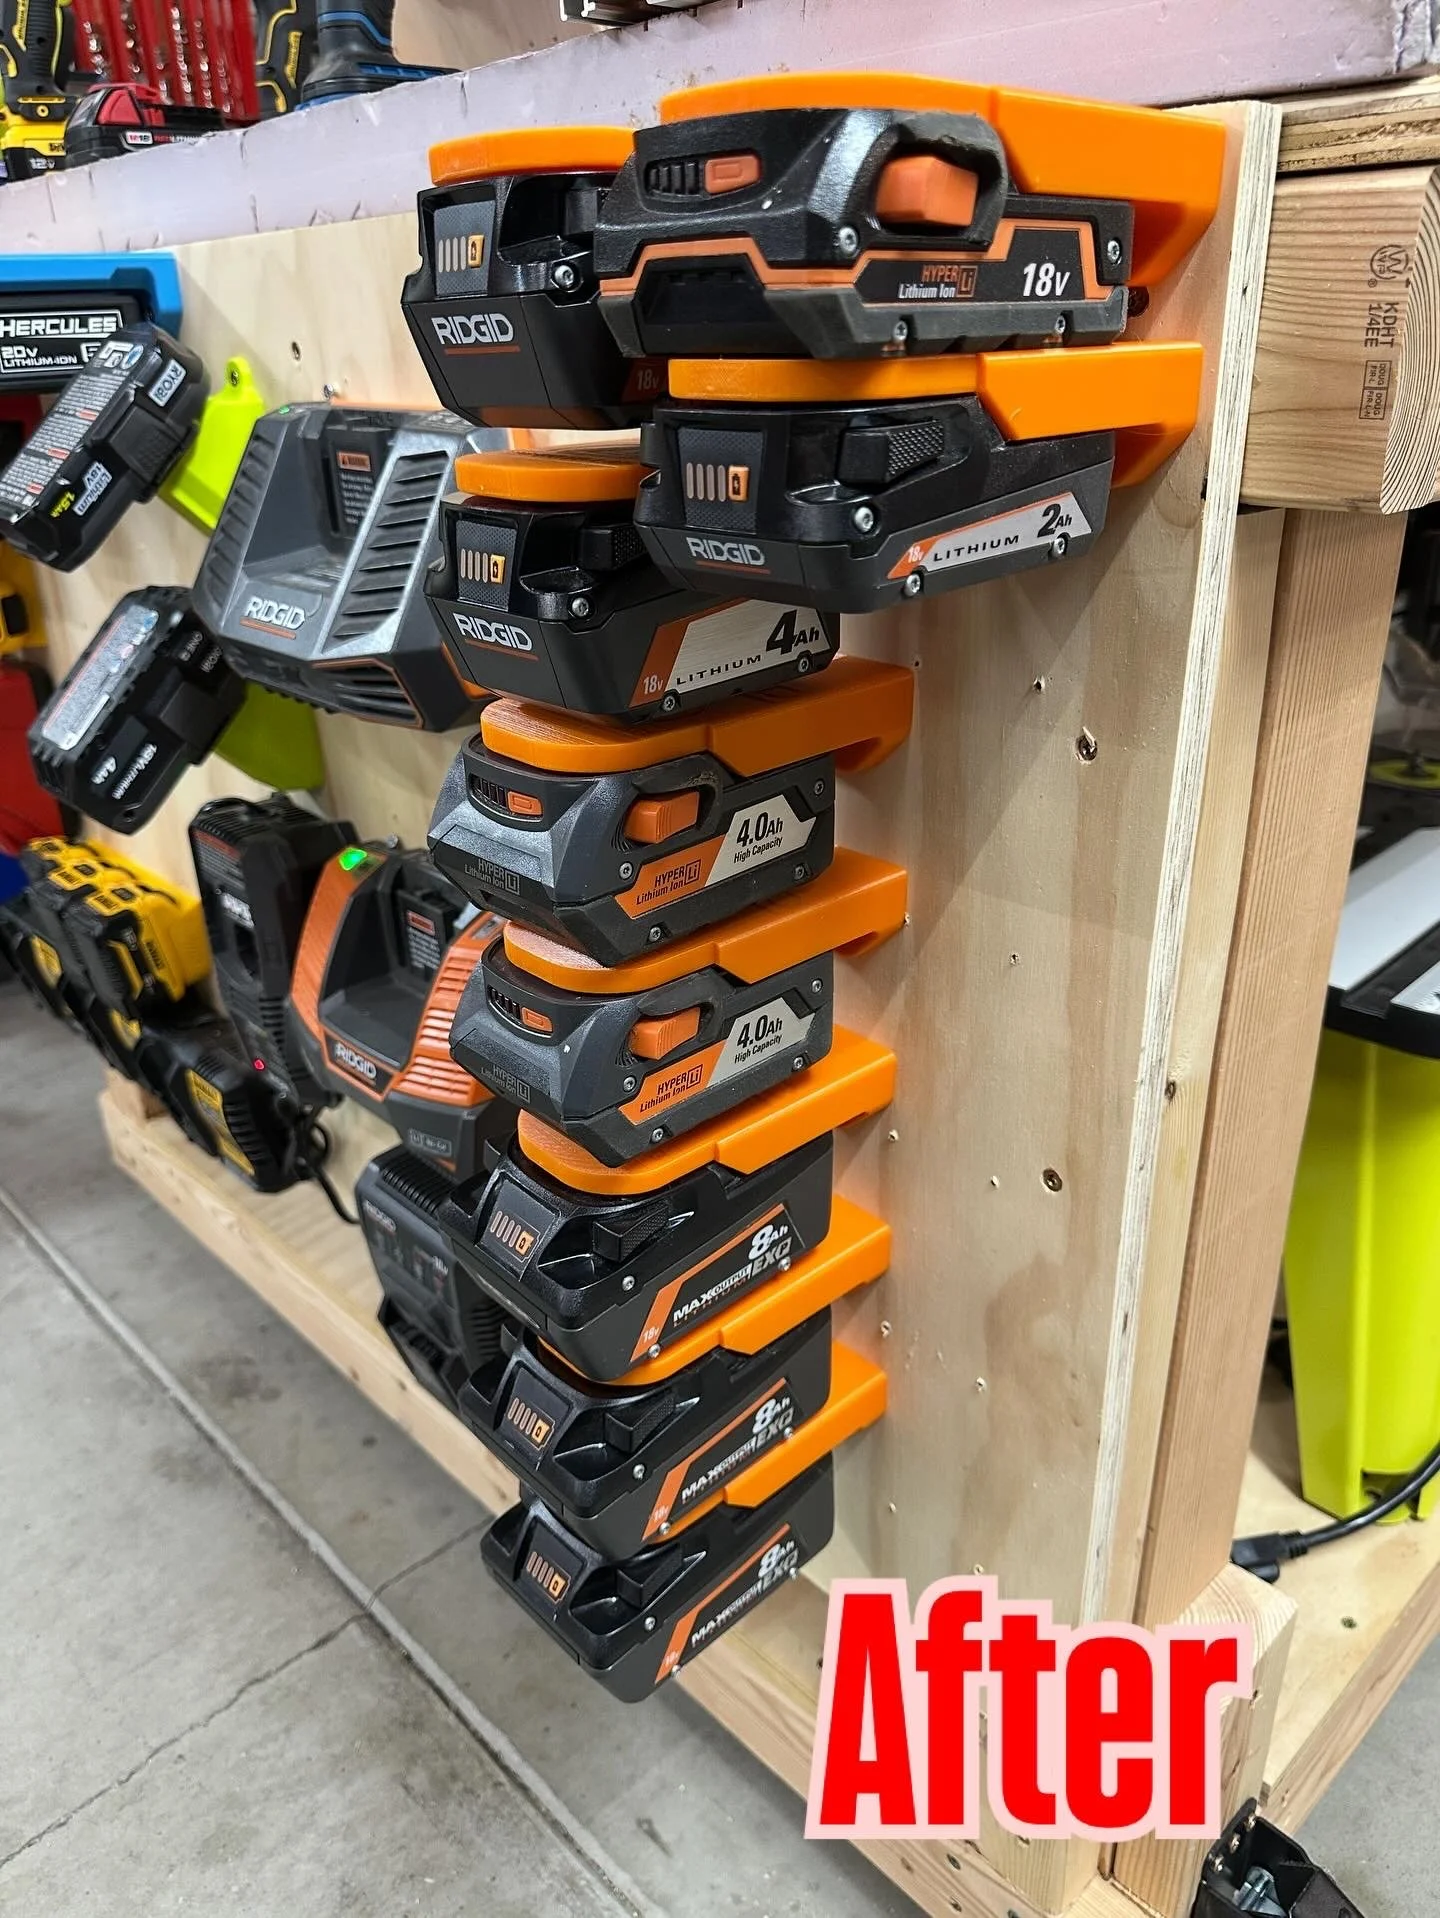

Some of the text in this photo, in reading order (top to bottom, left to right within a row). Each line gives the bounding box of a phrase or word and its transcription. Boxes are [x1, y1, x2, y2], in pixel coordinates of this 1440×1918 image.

[921, 265, 960, 282] HYPER
[898, 283, 955, 299] Lithium Ion
[0, 316, 117, 338] HERCULES
[430, 312, 514, 345] RIDGID
[1380, 302, 1399, 348] KDHT
[153, 363, 182, 402] RYOBI
[1377, 363, 1387, 386] DOUG
[1373, 392, 1383, 416] DOUG
[1036, 503, 1072, 539] 2Ah
[685, 536, 765, 567] RIDGID
[933, 535, 1019, 562] LITHIUM
[244, 596, 306, 631] RIDGID
[452, 612, 533, 652] RIDGID
[766, 609, 820, 656] 4Ah
[676, 654, 762, 686] LITHIUM
[736, 811, 783, 848] 4.0Ah
[734, 836, 783, 864] High Capacity
[478, 858, 505, 881] HYPER
[654, 864, 685, 888] HYPER
[636, 880, 684, 905] Lithium Ion
[736, 1014, 783, 1049] 4.0Ah
[334, 1042, 377, 1079] RIDGID
[734, 1033, 783, 1064] High Capacity
[640, 1085, 686, 1113] Lithium Ion
[657, 1071, 687, 1096] HYPER
[748, 1224, 789, 1260] 8Ah
[752, 1397, 791, 1434] 8Ah
